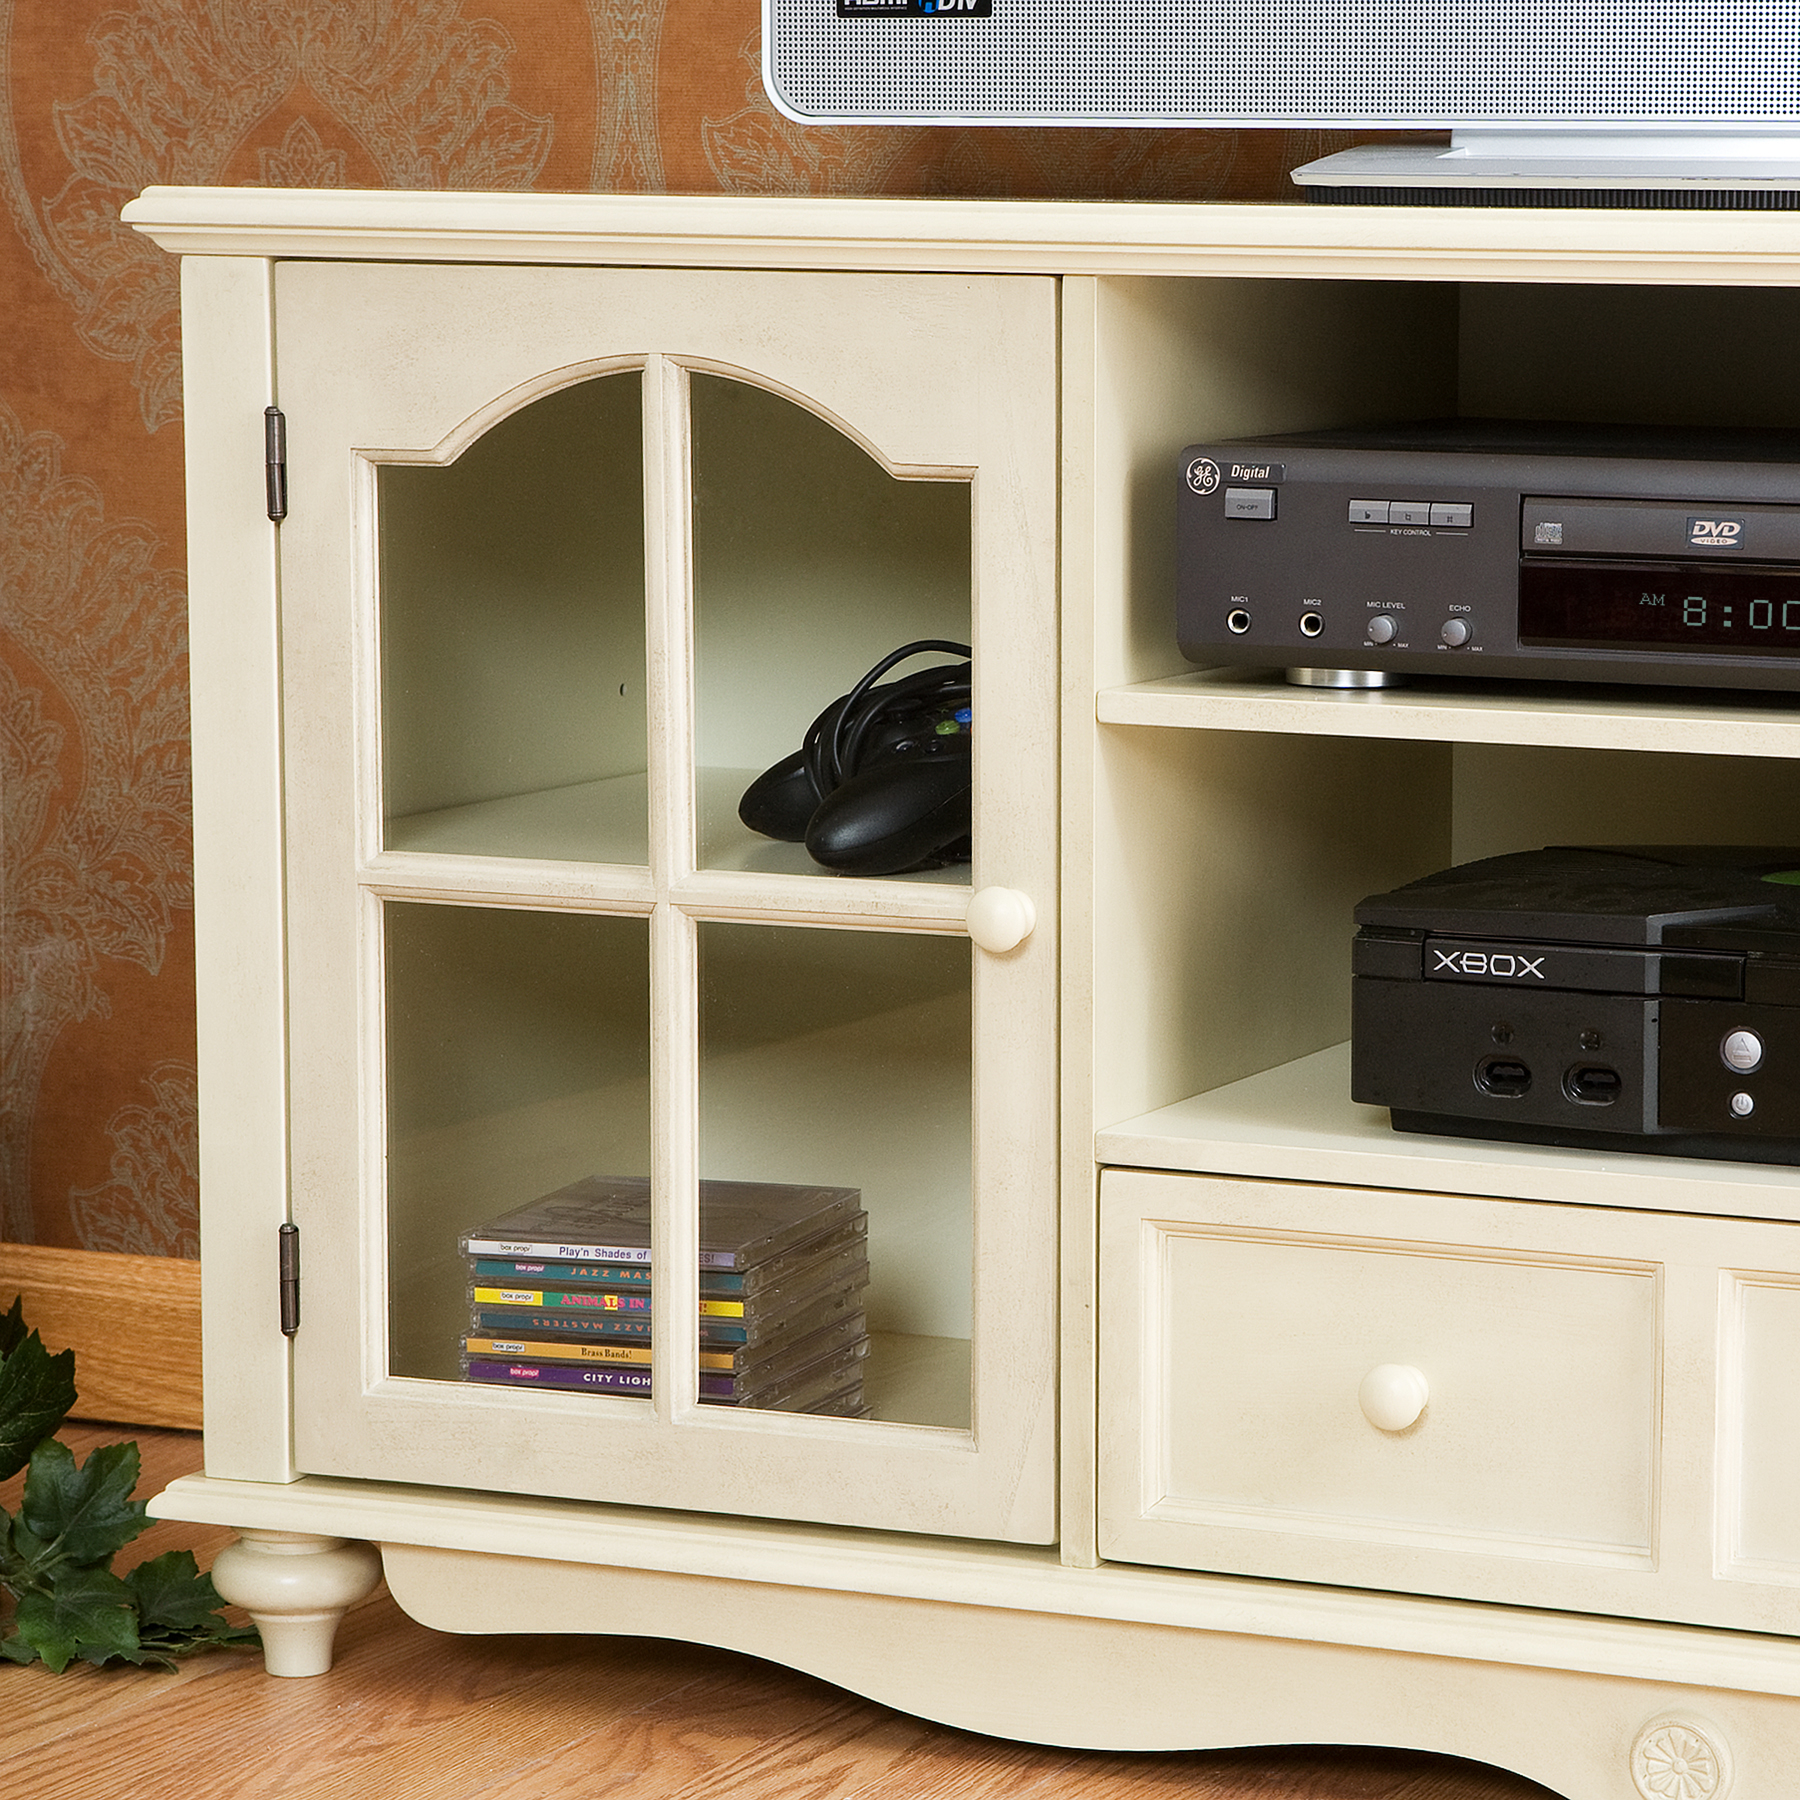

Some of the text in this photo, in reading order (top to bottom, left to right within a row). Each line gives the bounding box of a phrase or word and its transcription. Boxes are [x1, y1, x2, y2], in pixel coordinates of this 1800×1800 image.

[1230, 464, 1270, 481] Digital
[1402, 529, 1432, 537] CONTROL
[1692, 520, 1741, 537] DVD
[1230, 595, 1249, 603] MIC1
[1303, 598, 1322, 606] MIC2
[1639, 593, 1666, 606] AM
[1382, 602, 1406, 610] LEVEL
[1448, 604, 1472, 612] ECHO
[1433, 950, 1546, 980] XBOX
[500, 1243, 512, 1251] box
[559, 1246, 590, 1259] Play'n
[594, 1247, 632, 1259] Shades
[636, 1250, 647, 1260] of
[571, 1268, 610, 1277] JAZZ
[501, 1291, 513, 1299] box
[560, 1293, 626, 1309] ANIMALS
[629, 1298, 645, 1309] IN
[532, 1318, 604, 1330] MASTERS
[581, 1347, 632, 1359] Brass Bands!
[583, 1373, 613, 1383] CITY
